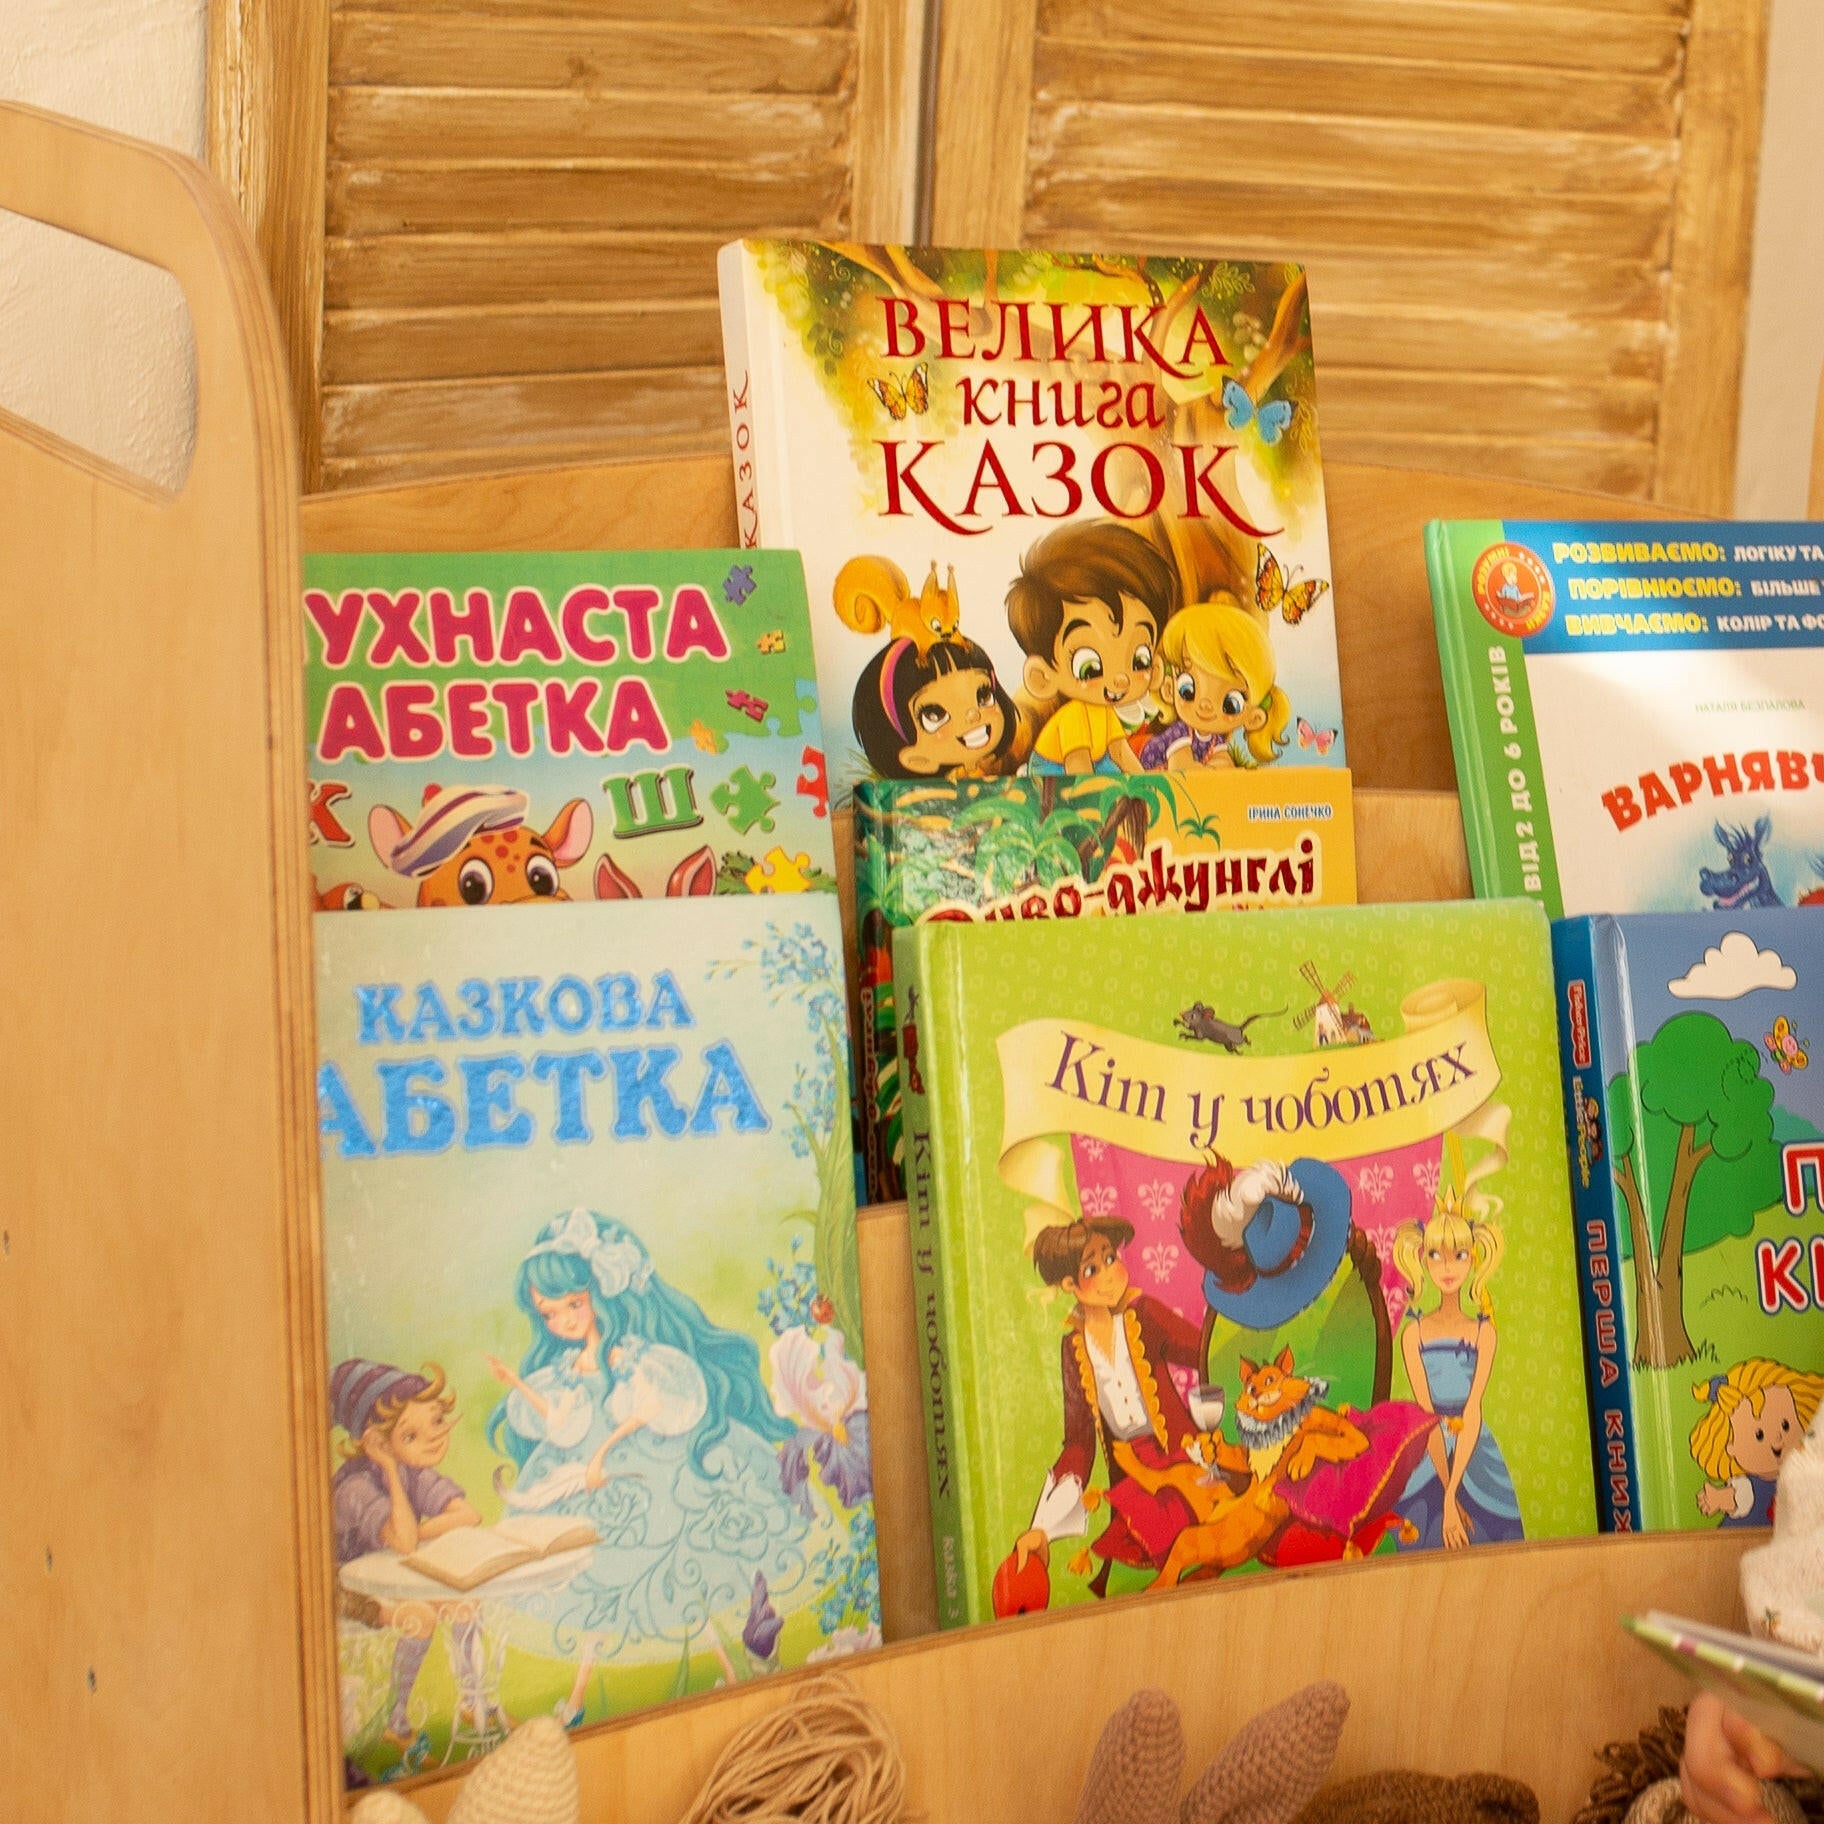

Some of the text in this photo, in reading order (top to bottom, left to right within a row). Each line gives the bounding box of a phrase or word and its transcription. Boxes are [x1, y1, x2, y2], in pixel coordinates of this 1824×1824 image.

[877, 296, 1233, 379] ВЕЛИКА
[955, 376, 1166, 428] книга
[733, 370, 758, 548] КАЗОК
[872, 438, 1285, 537] КАЗОК
[1552, 542, 1726, 564] РОЗВИВАЄМО:
[1734, 545, 1796, 562] ЛОГІКУ
[1799, 545, 1824, 562] ТА
[302, 585, 731, 669] УХНАСТА
[1565, 612, 1709, 636] ВИВЧАЄМО:
[1716, 614, 1772, 632] КОЛІР
[1774, 614, 1800, 631] ТА
[316, 677, 672, 763] АБЕТКА
[1488, 645, 1542, 892] ВІД 2 ДО 6 РОКІВ
[354, 970, 697, 1045] КАЗКОВА
[317, 1040, 772, 1161] АБЕТКА
[1045, 1031, 1477, 1150] Кіт у чоботях
[914, 1131, 950, 1499] Кіт у чоботях
[1587, 1219, 1632, 1534] ПЕРША КНИЖ
